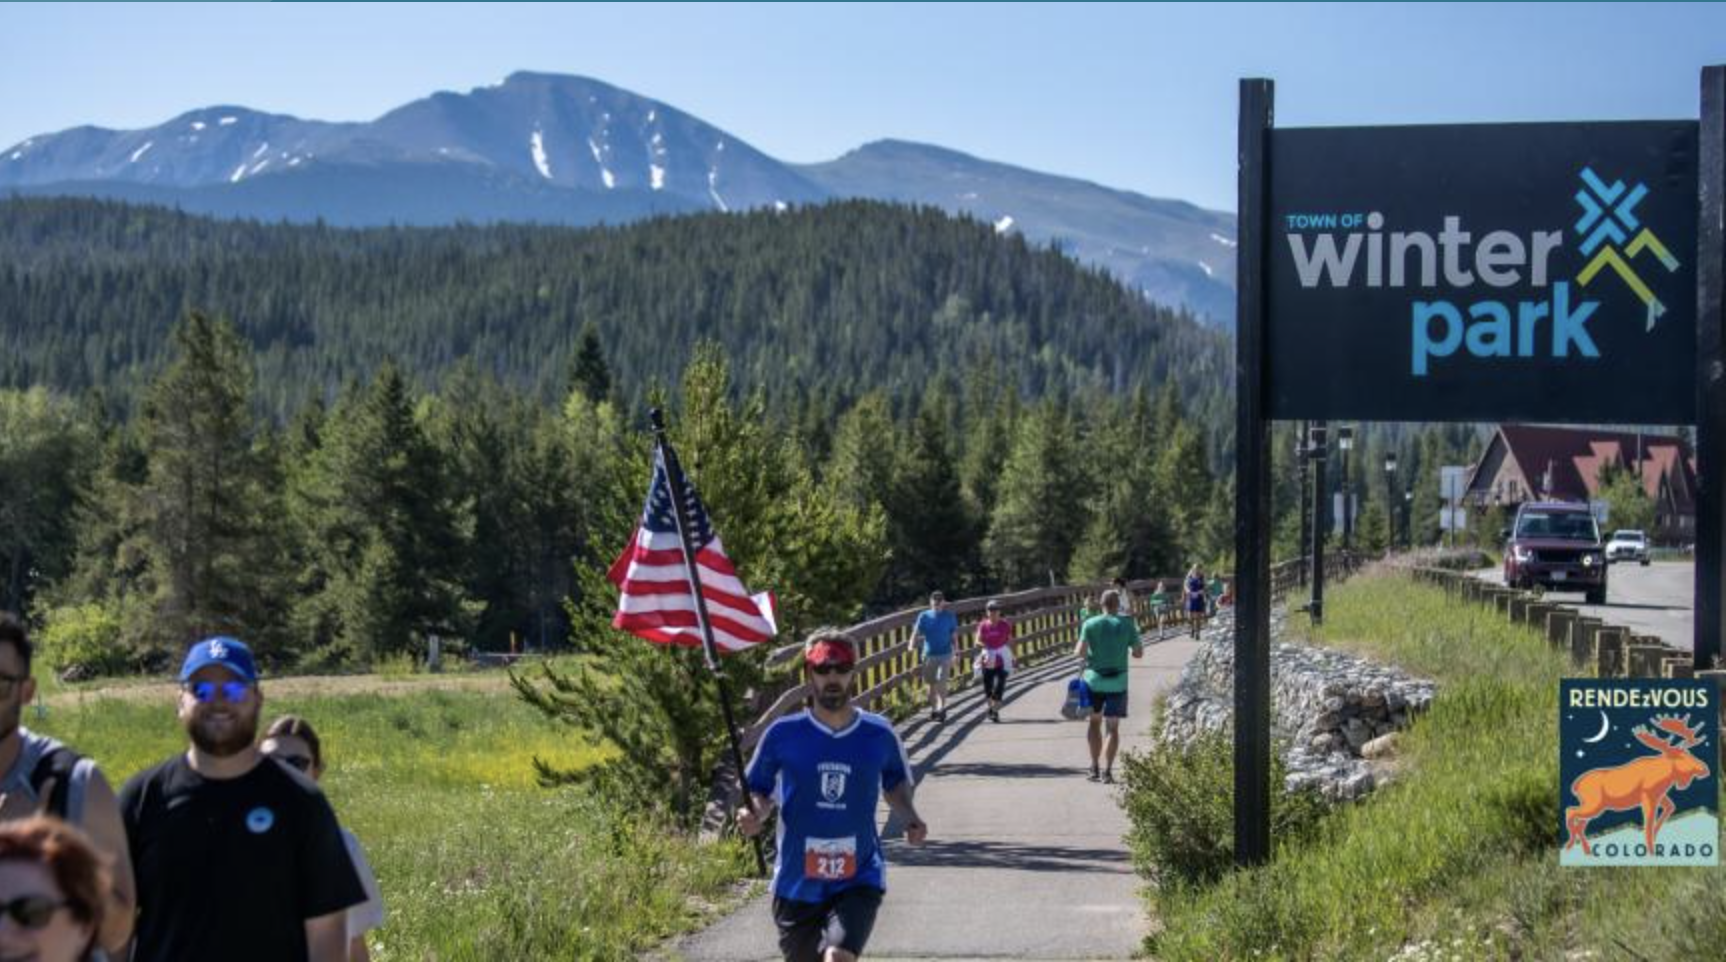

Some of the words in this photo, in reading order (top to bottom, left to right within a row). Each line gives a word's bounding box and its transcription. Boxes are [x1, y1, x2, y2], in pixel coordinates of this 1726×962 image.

[1287, 214, 1337, 230] TOWN
[1341, 213, 1363, 229] OF
[1286, 211, 1563, 288] winter
[1410, 281, 1601, 376] park
[209, 640, 228, 658] LA
[818, 858, 845, 874] 212
